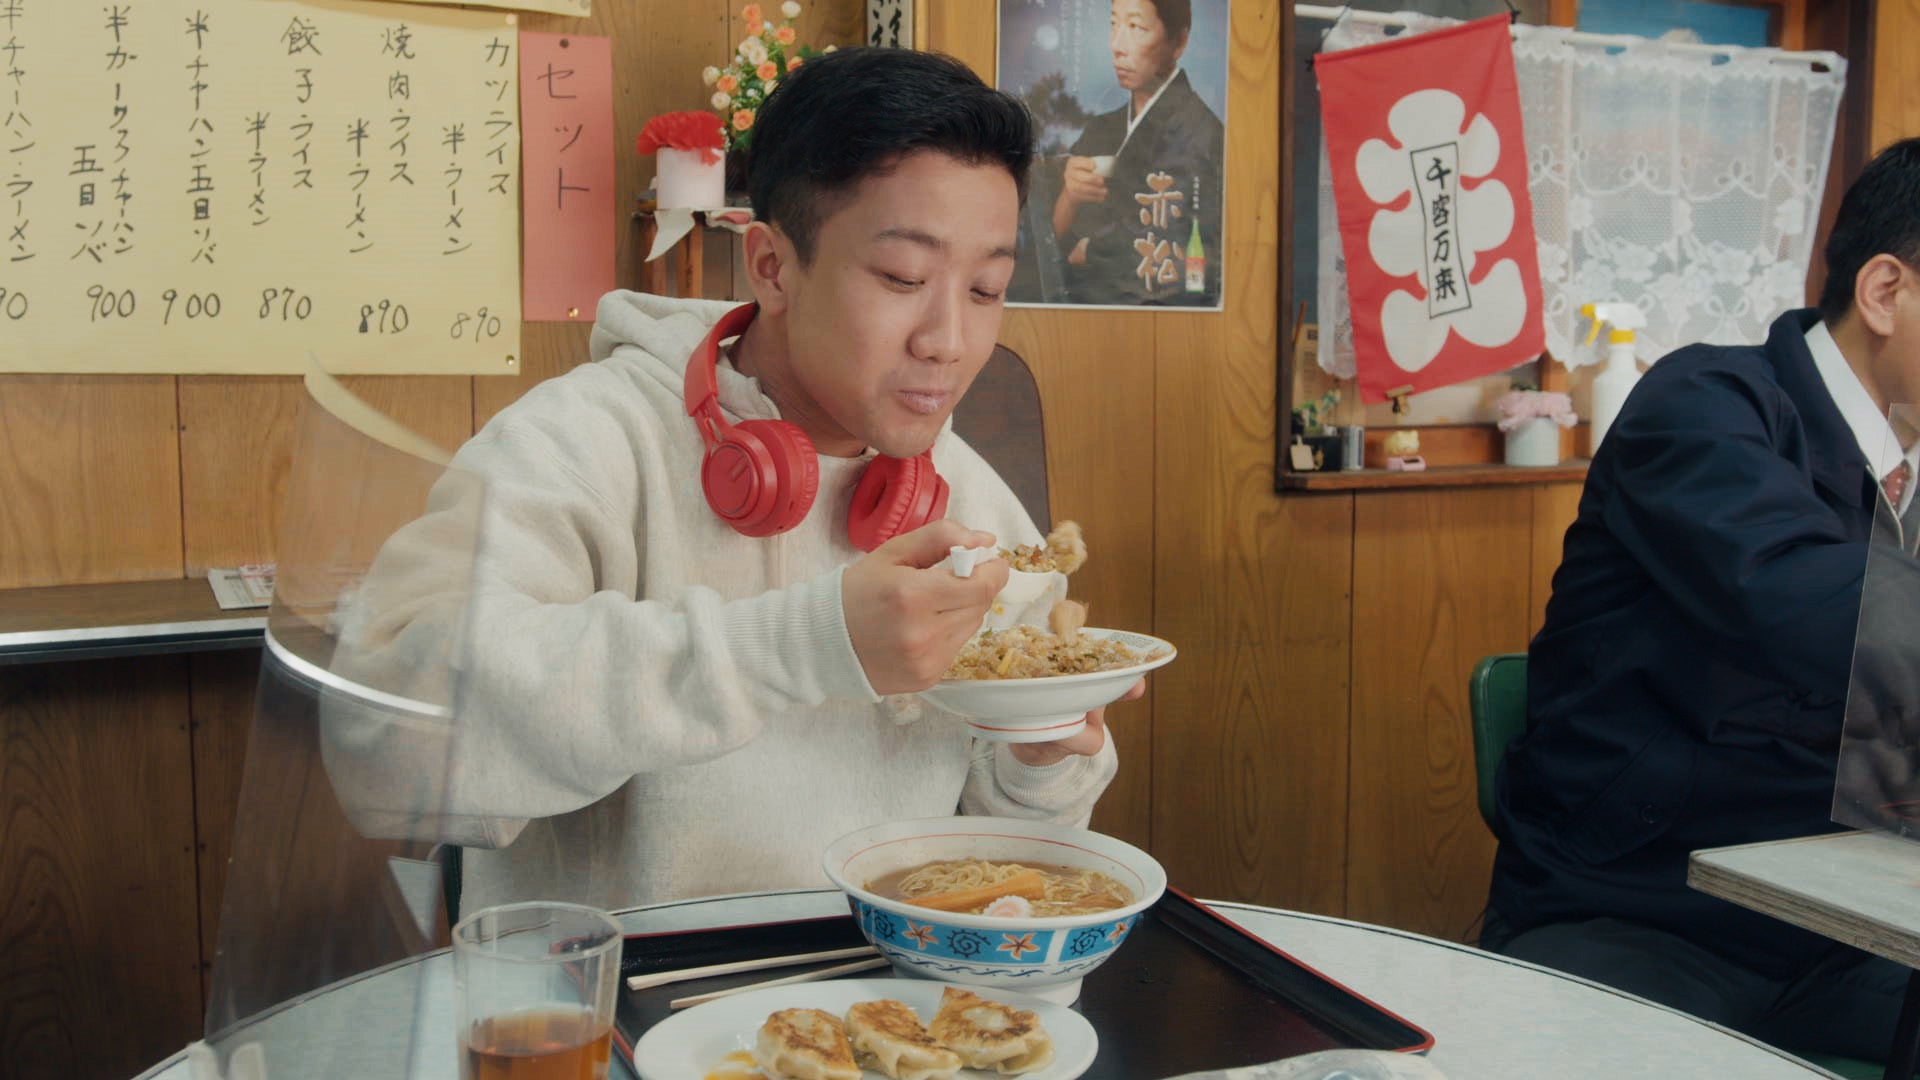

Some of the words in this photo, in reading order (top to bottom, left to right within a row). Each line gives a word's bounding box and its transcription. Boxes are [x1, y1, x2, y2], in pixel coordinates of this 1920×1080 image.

[280, 16, 322, 188] 餃子ライス
[381, 24, 415, 185] 焼肉ライス
[485, 37, 512, 194] カツライス
[537, 64, 590, 210] セット
[69, 144, 107, 263] 五目ソバ
[245, 112, 270, 226] 半ラーメン
[346, 118, 373, 253] 半ラーメン
[442, 123, 472, 255] 半ラーメン
[1426, 157, 1457, 302] 千客万来
[1134, 171, 1184, 292] 赤松
[86, 284, 136, 322] 900
[162, 289, 221, 325] 900
[259, 286, 312, 321] 870
[358, 299, 409, 334] 890
[451, 307, 500, 343] 890
